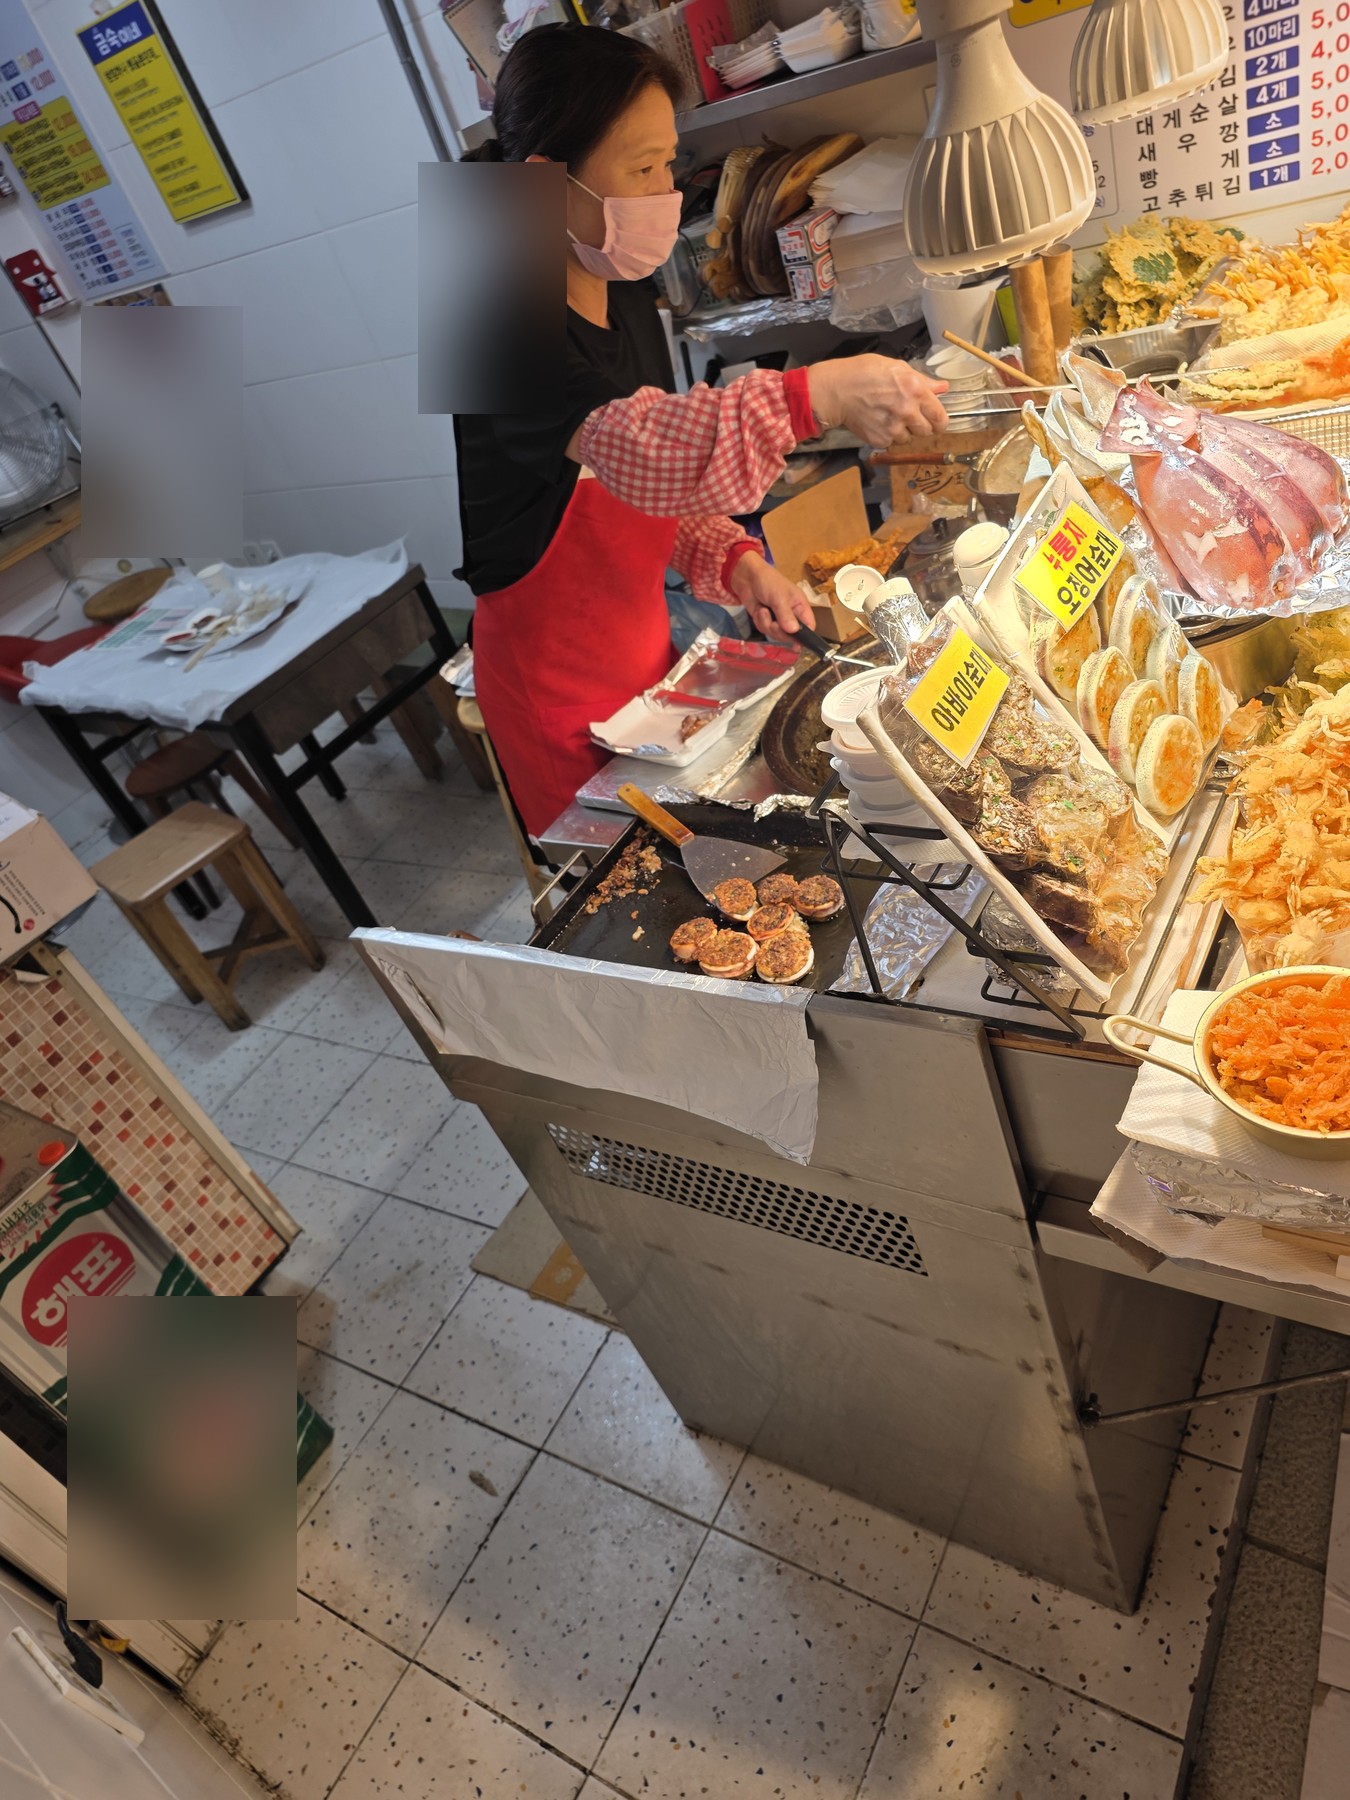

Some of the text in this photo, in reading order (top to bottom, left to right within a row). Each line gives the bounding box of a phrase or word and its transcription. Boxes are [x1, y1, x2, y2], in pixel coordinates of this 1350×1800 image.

[1247, 0, 1295, 16] 4마
[1248, 17, 1296, 48] 10마리
[1256, 50, 1287, 76] 2개
[1256, 81, 1287, 103] 4개
[1265, 112, 1283, 130] 소
[1265, 141, 1283, 158] 소
[1142, 175, 1241, 214] 고추튀김
[1260, 165, 1289, 187] 1개
[1044, 517, 1088, 571] 누룽지
[1056, 529, 1119, 616] 오징어순대
[930, 647, 993, 733] 아바이순대
[30, 1239, 122, 1328] 해표
